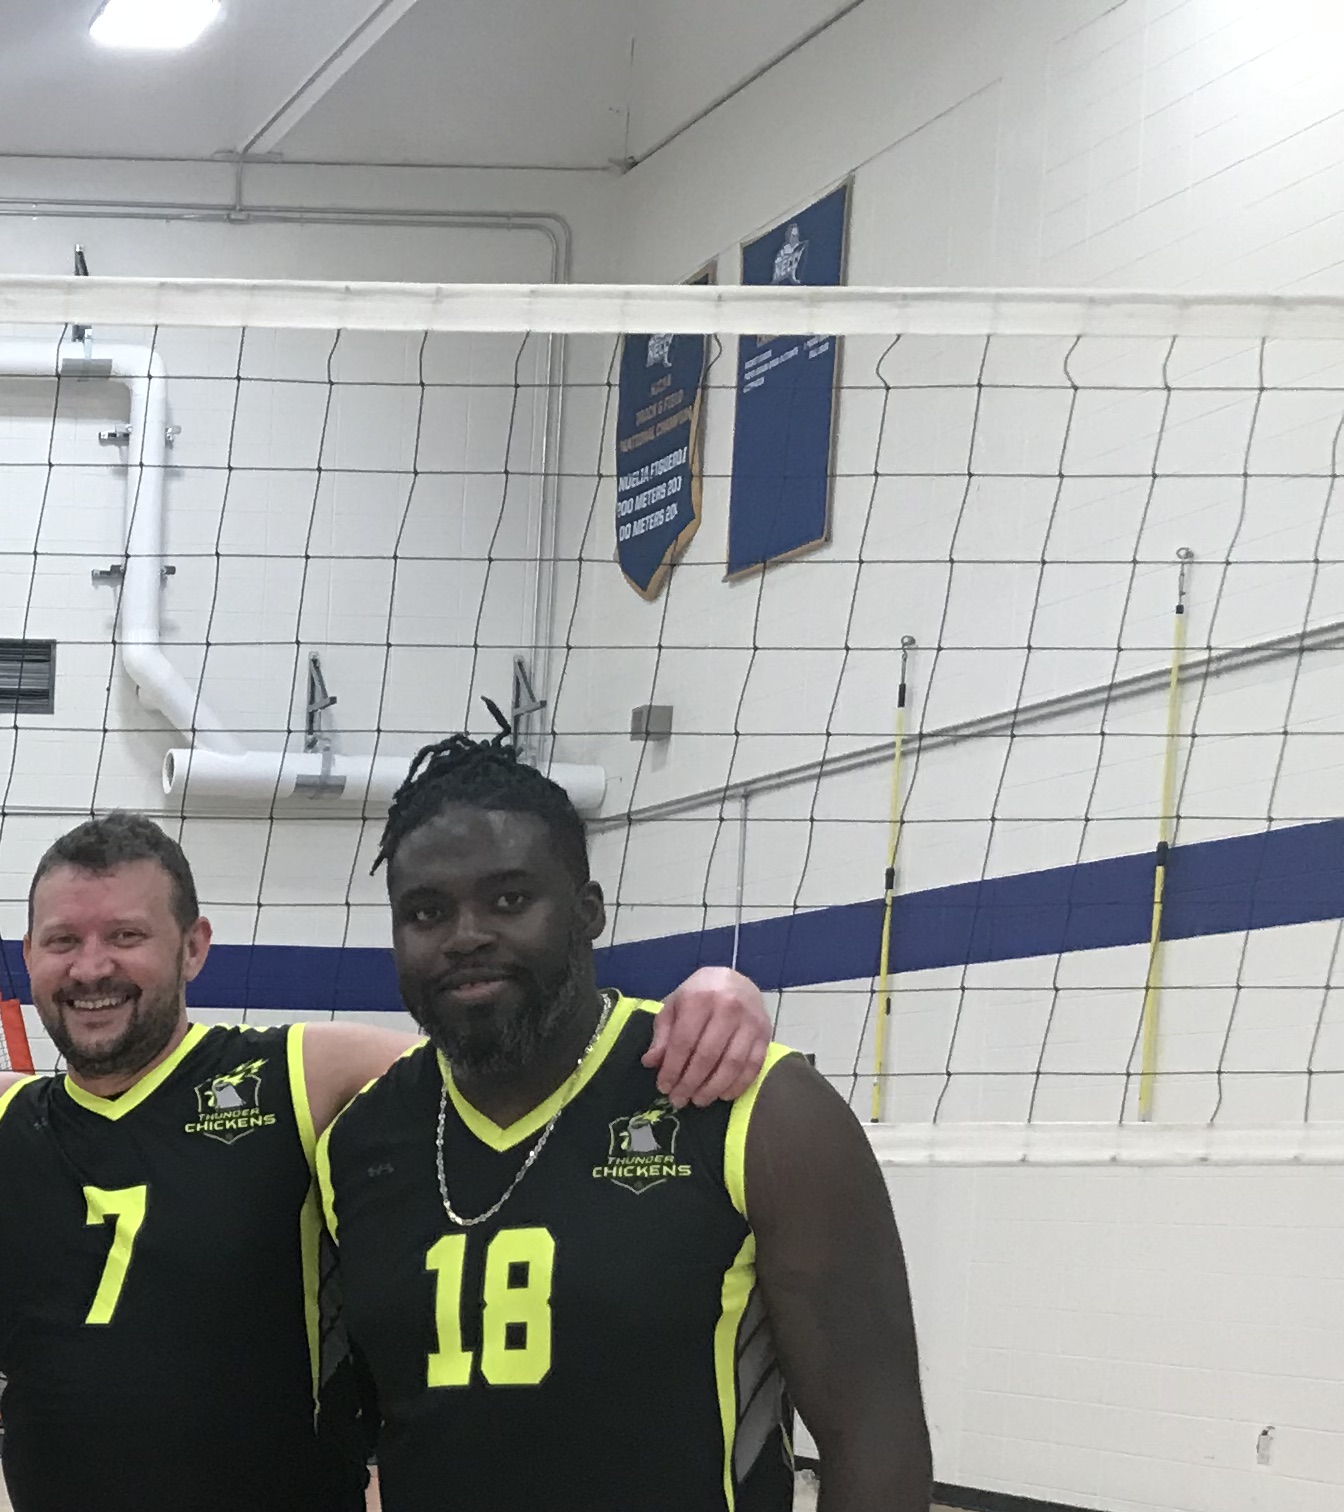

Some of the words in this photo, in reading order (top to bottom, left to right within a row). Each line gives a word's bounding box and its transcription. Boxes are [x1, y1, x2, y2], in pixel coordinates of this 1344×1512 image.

[198, 1107, 260, 1121] THUNDER
[184, 1113, 277, 1133] CHICKENS
[608, 1154, 675, 1165] THUNDER
[592, 1164, 692, 1178] CHICKENS
[83, 1185, 147, 1325] 7
[425, 1227, 556, 1388] 18
